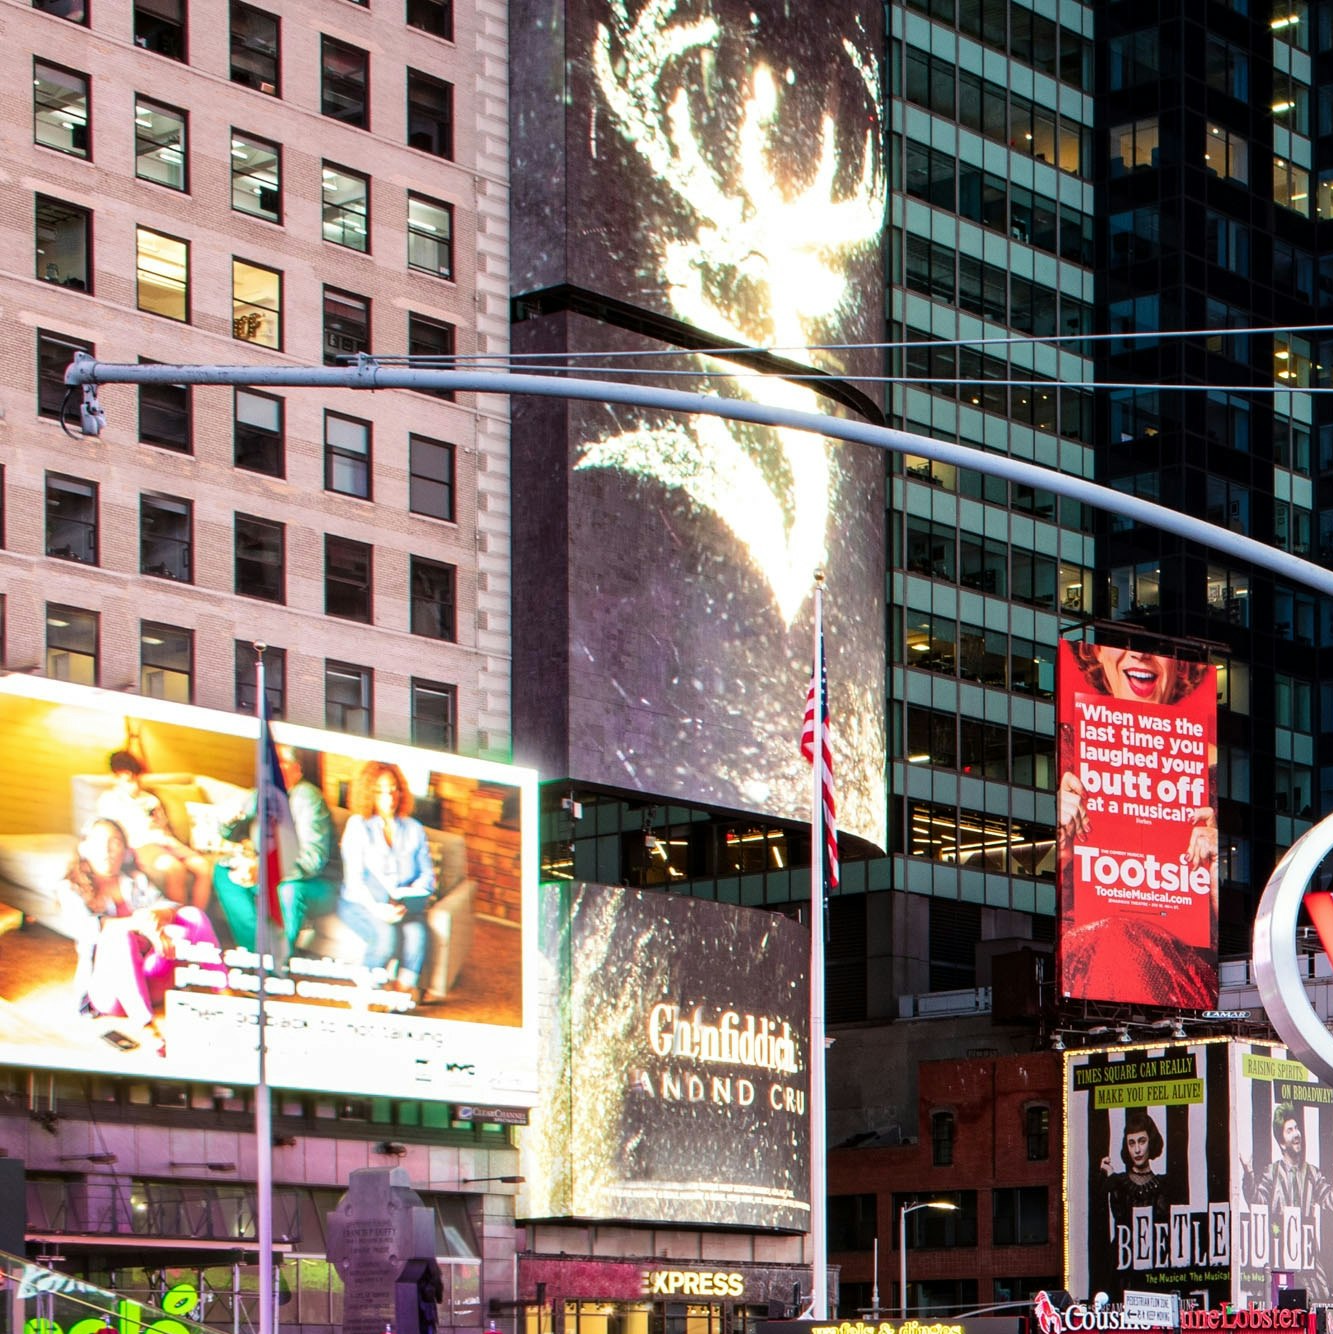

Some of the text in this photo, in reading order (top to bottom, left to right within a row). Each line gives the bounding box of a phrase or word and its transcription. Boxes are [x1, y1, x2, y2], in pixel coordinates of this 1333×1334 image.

[1075, 702, 1203, 737] “When was the
[1080, 720, 1204, 755] last time you
[1080, 741, 1204, 775] laughed your
[1080, 762, 1204, 806] butt off
[1087, 796, 1104, 812] at
[1108, 800, 1118, 813] a
[1074, 845, 1211, 895] Tootsie
[1095, 885, 1192, 905] TootsieMusical.com
[1076, 1057, 1193, 1085] TIMES SQUARE CAN REALLY
[1247, 1059, 1303, 1080] RAISING SPIRITS
[1098, 1082, 1200, 1105] MAKE YOU FEEL ALIVE!
[1281, 1083, 1333, 1104] ON BROADWAY!
[1116, 1202, 1230, 1271] BEETLE
[640, 1271, 744, 1297] EXPRESS
[1146, 1273, 1158, 1284] The
[1190, 1271, 1202, 1282] The
[1219, 1301, 1304, 1330] Lobster
